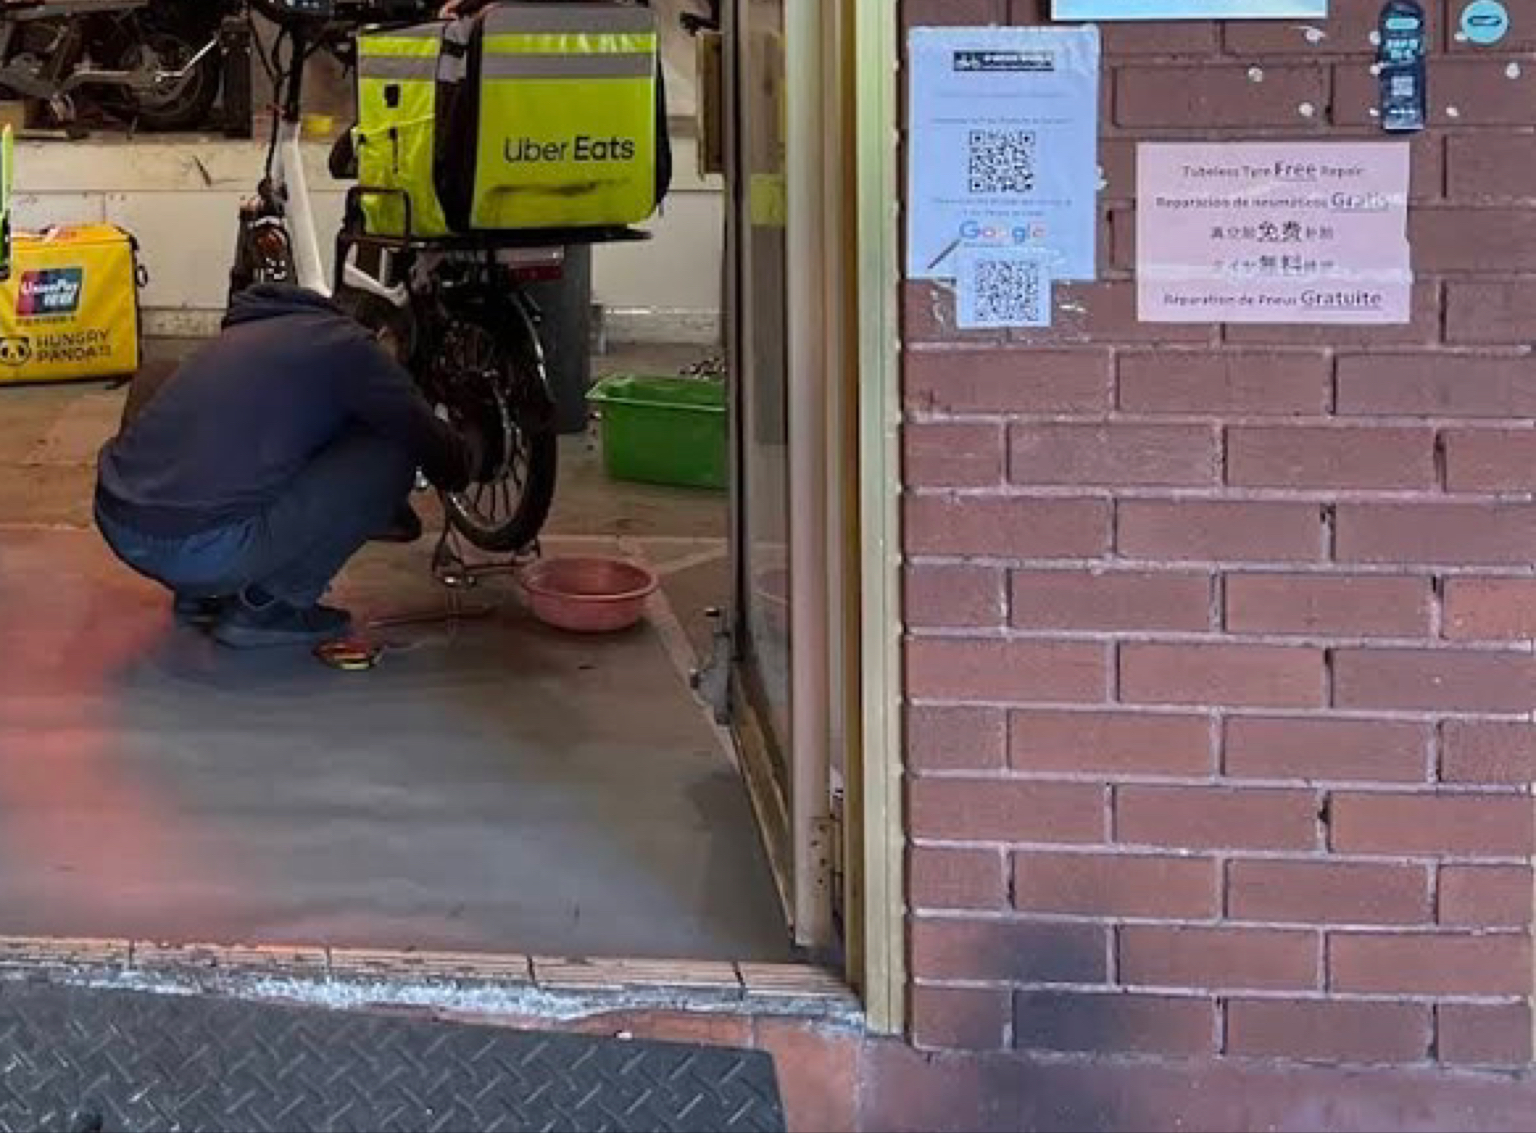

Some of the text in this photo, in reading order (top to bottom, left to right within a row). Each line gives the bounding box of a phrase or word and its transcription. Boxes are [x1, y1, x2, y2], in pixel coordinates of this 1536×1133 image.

[505, 135, 635, 163] Uber Eats
[1275, 162, 1317, 176] Free
[1301, 290, 1383, 306] Gratuite
